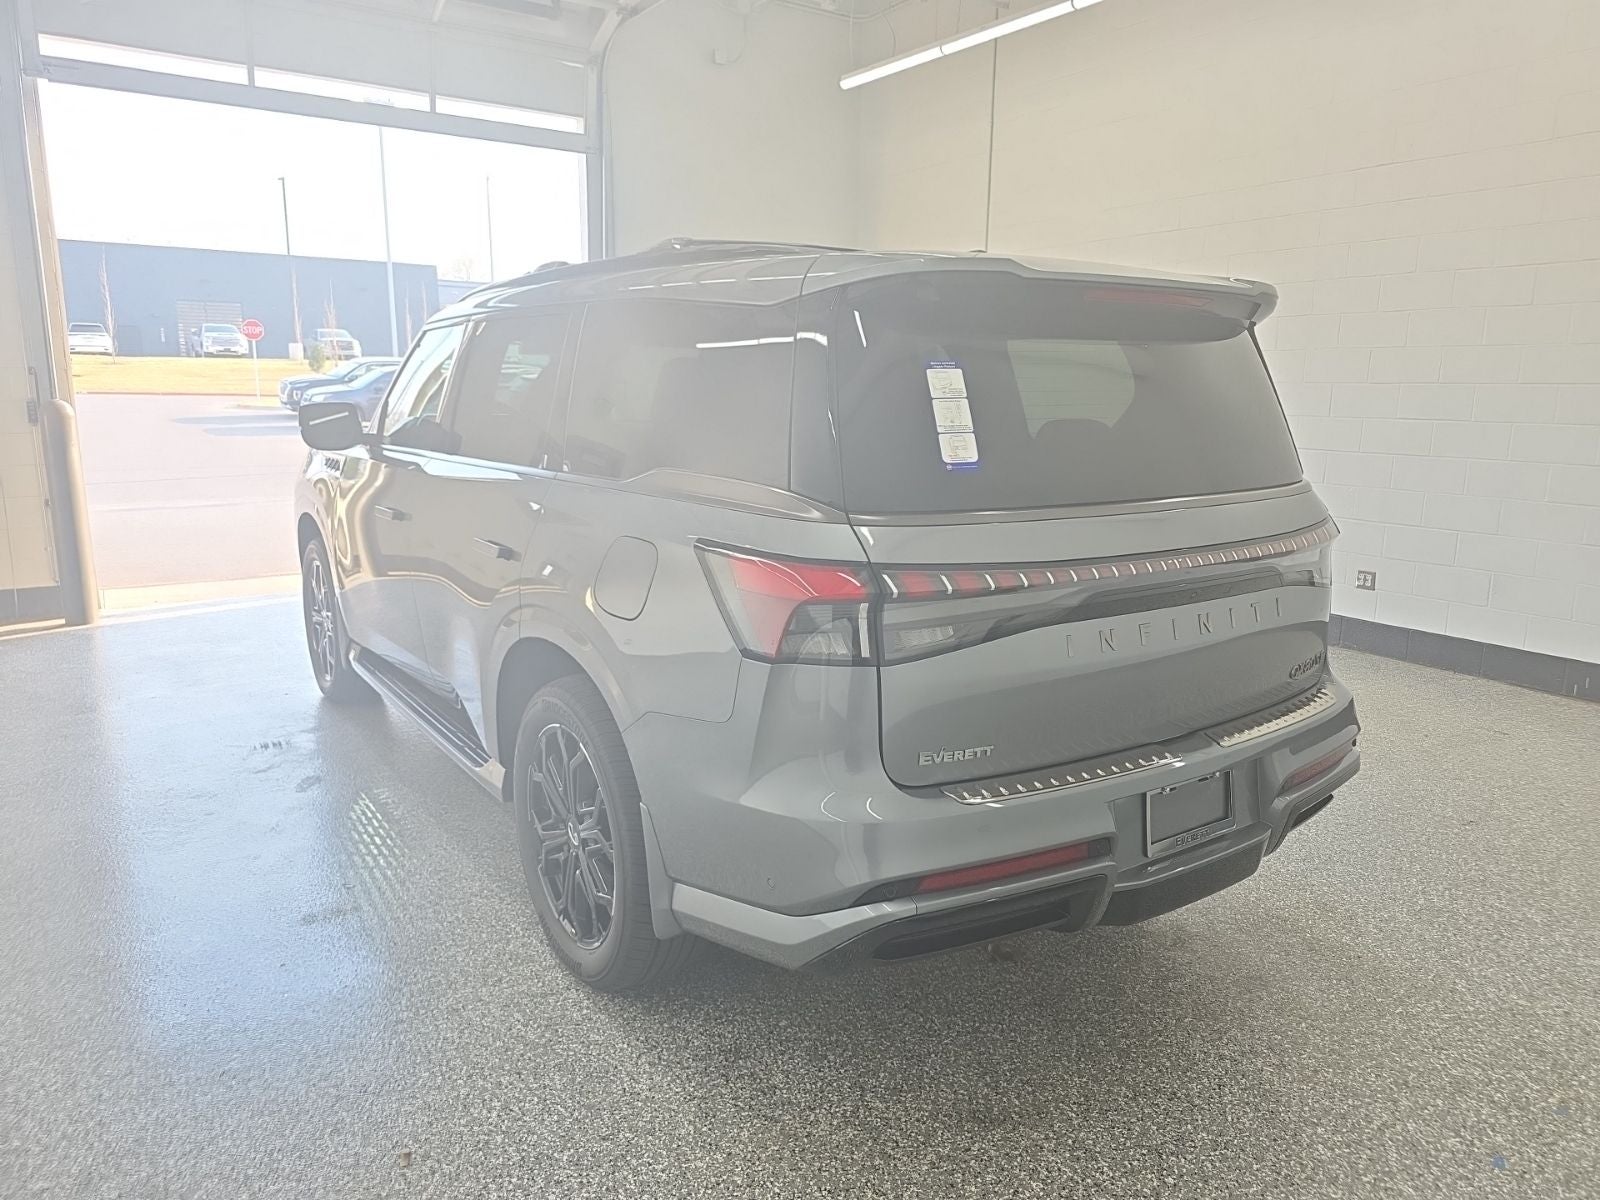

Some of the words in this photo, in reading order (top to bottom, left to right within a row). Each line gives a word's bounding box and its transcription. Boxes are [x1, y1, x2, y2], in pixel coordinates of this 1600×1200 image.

[243, 325, 262, 334] STOP
[1065, 597, 1282, 658] INFINITI
[918, 745, 995, 766] EVERETT
